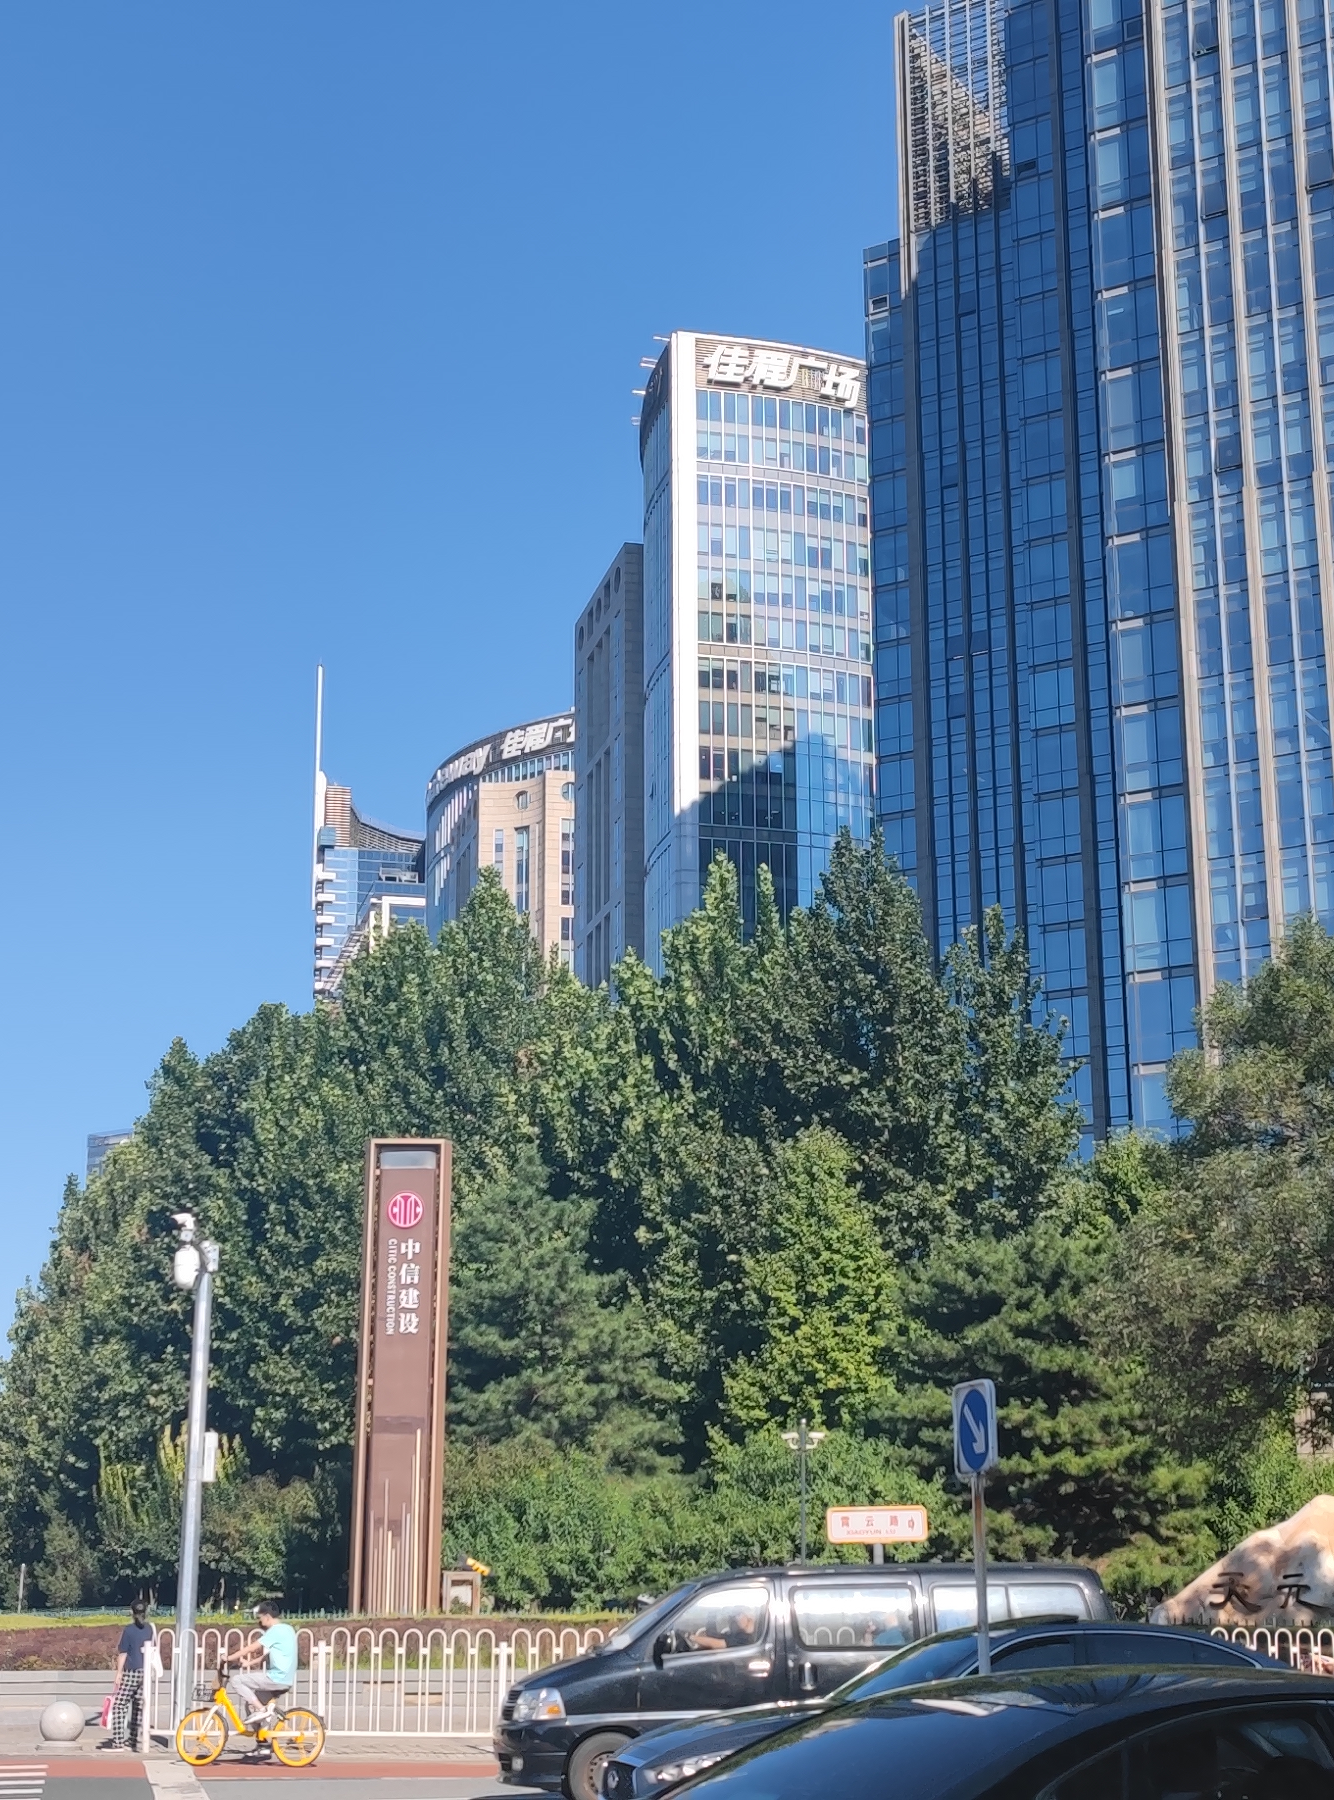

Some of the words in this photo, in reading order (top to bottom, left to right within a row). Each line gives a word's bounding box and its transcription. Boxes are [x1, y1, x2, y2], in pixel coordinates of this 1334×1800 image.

[702, 344, 861, 408] 佳程广场
[387, 1238, 398, 1264] CITIC
[385, 1265, 397, 1335] CONSTRUCTION
[398, 1238, 421, 1335] 中信建设
